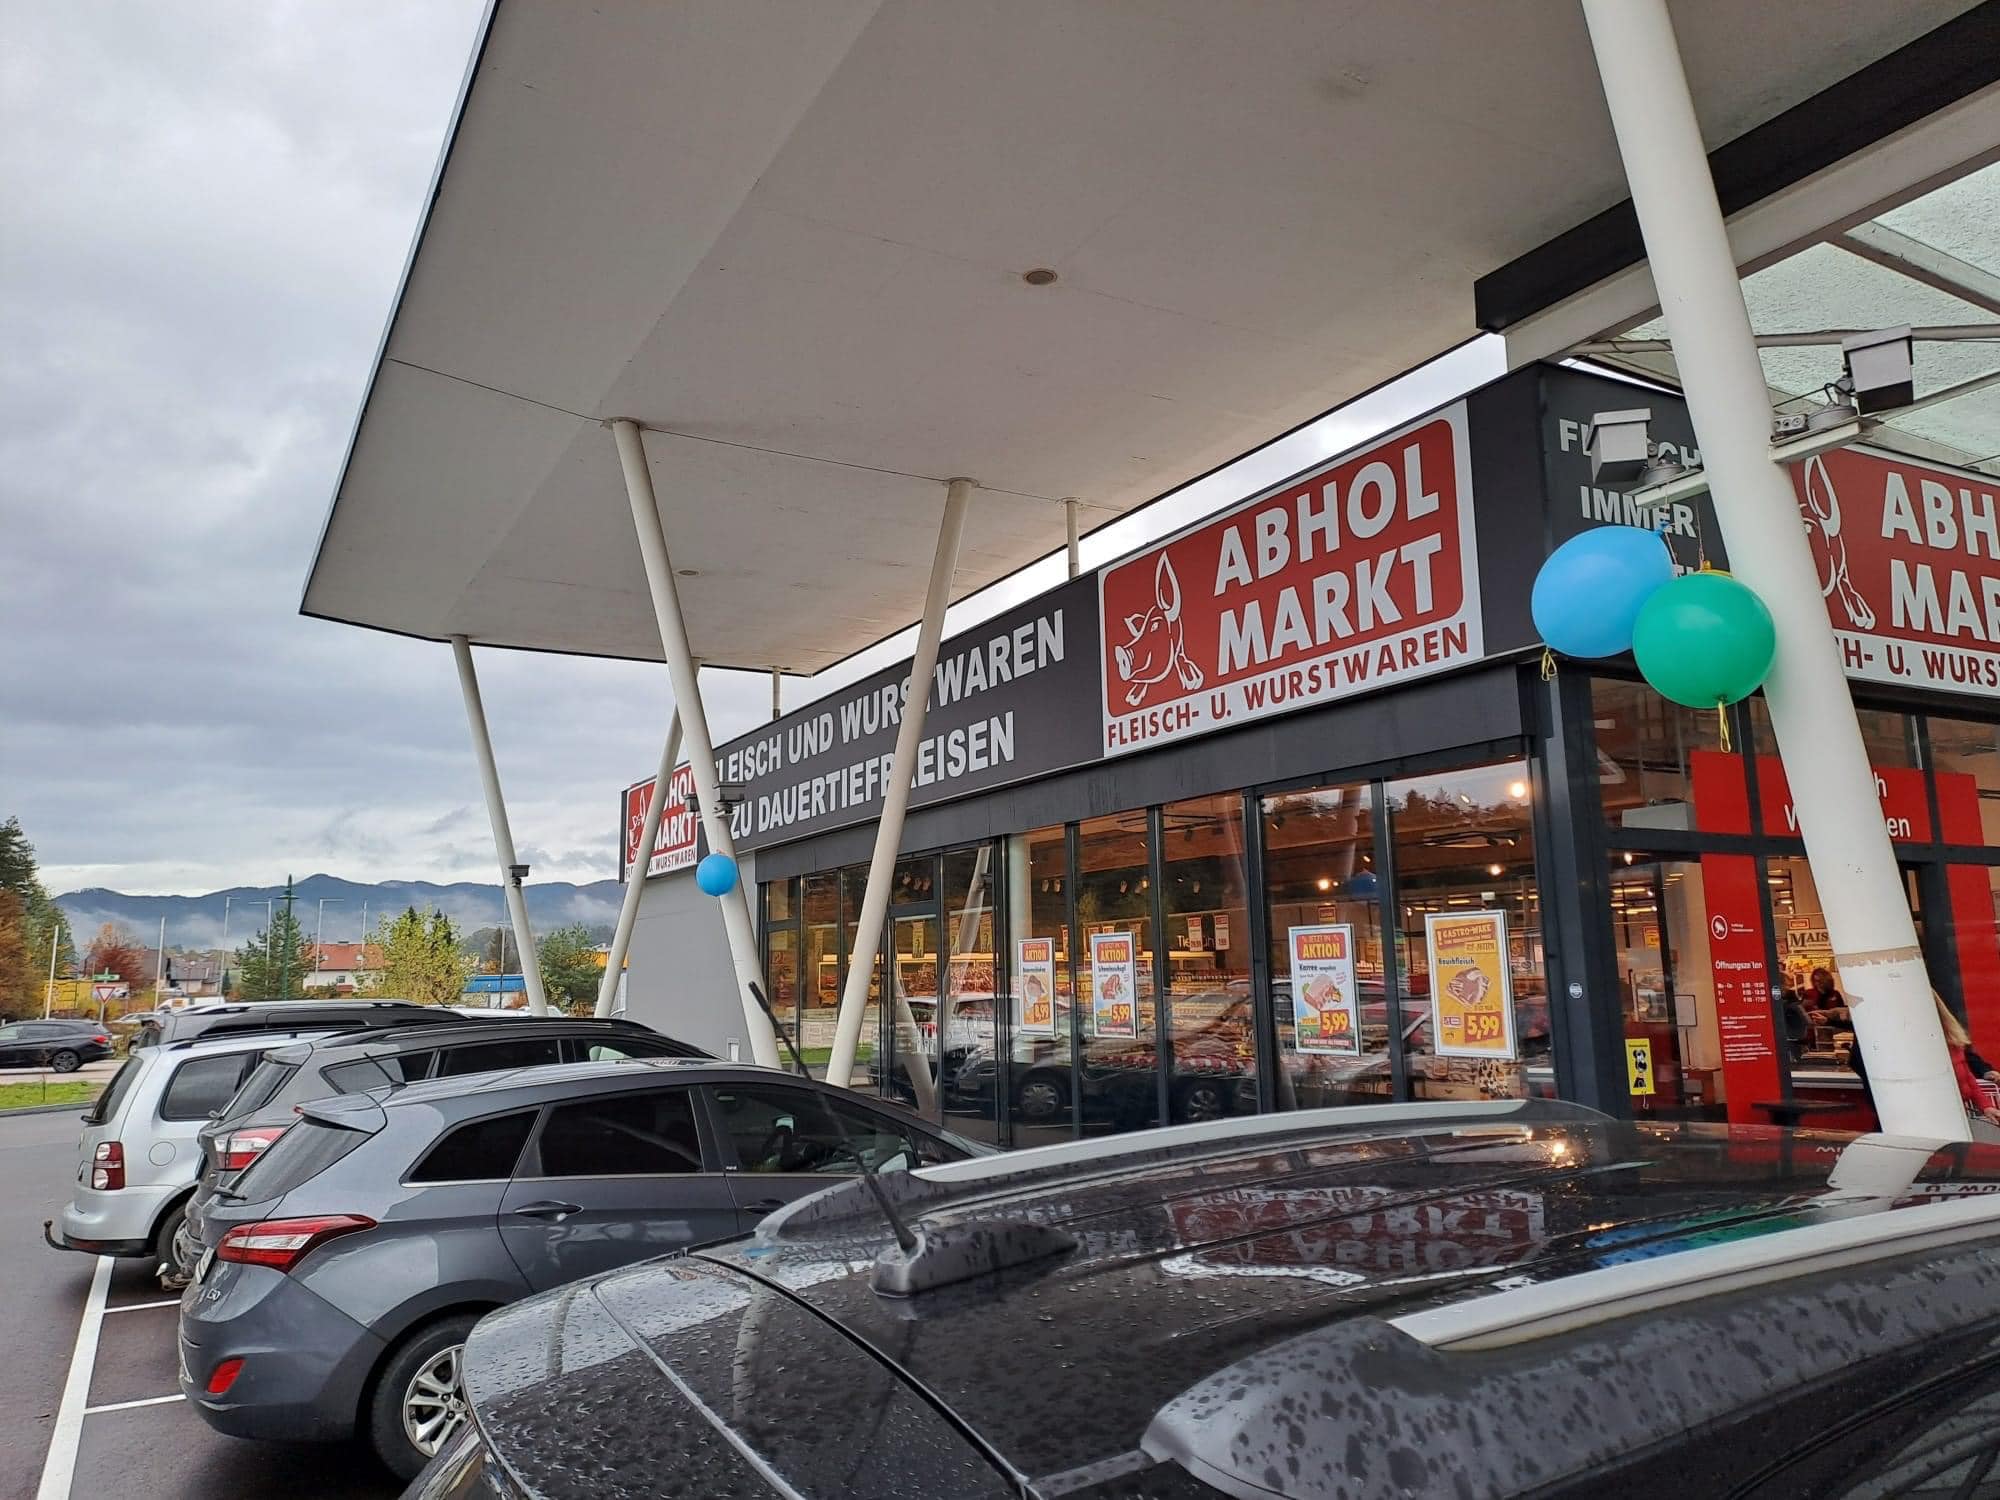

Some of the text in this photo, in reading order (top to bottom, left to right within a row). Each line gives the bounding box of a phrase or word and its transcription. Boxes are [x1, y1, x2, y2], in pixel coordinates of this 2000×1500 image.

[1213, 443, 1440, 597] ABHOL
[1580, 485, 1697, 538] IMMER
[1881, 471, 2000, 560] ABH
[1217, 532, 1442, 677] MARKT
[1107, 622, 1468, 748] FLEISCH- U. WURSTWAREN
[1886, 644, 1911, 677] U.
[1922, 650, 2000, 688] WURS
[715, 609, 1065, 783] LEISCH UND WURWAREN
[663, 770, 697, 812] HOL
[730, 711, 1015, 840] ZU DAUERTIEFPEISEN
[656, 848, 696, 870] WURSTWAREN
[1024, 949, 1047, 960] AKTION
[1100, 949, 1127, 961] AKTION
[1302, 943, 1341, 959] AKTION
[1113, 1005, 1130, 1023] 5,99
[1322, 1012, 1348, 1035] 5,99
[1467, 1015, 1500, 1040] 5,99
